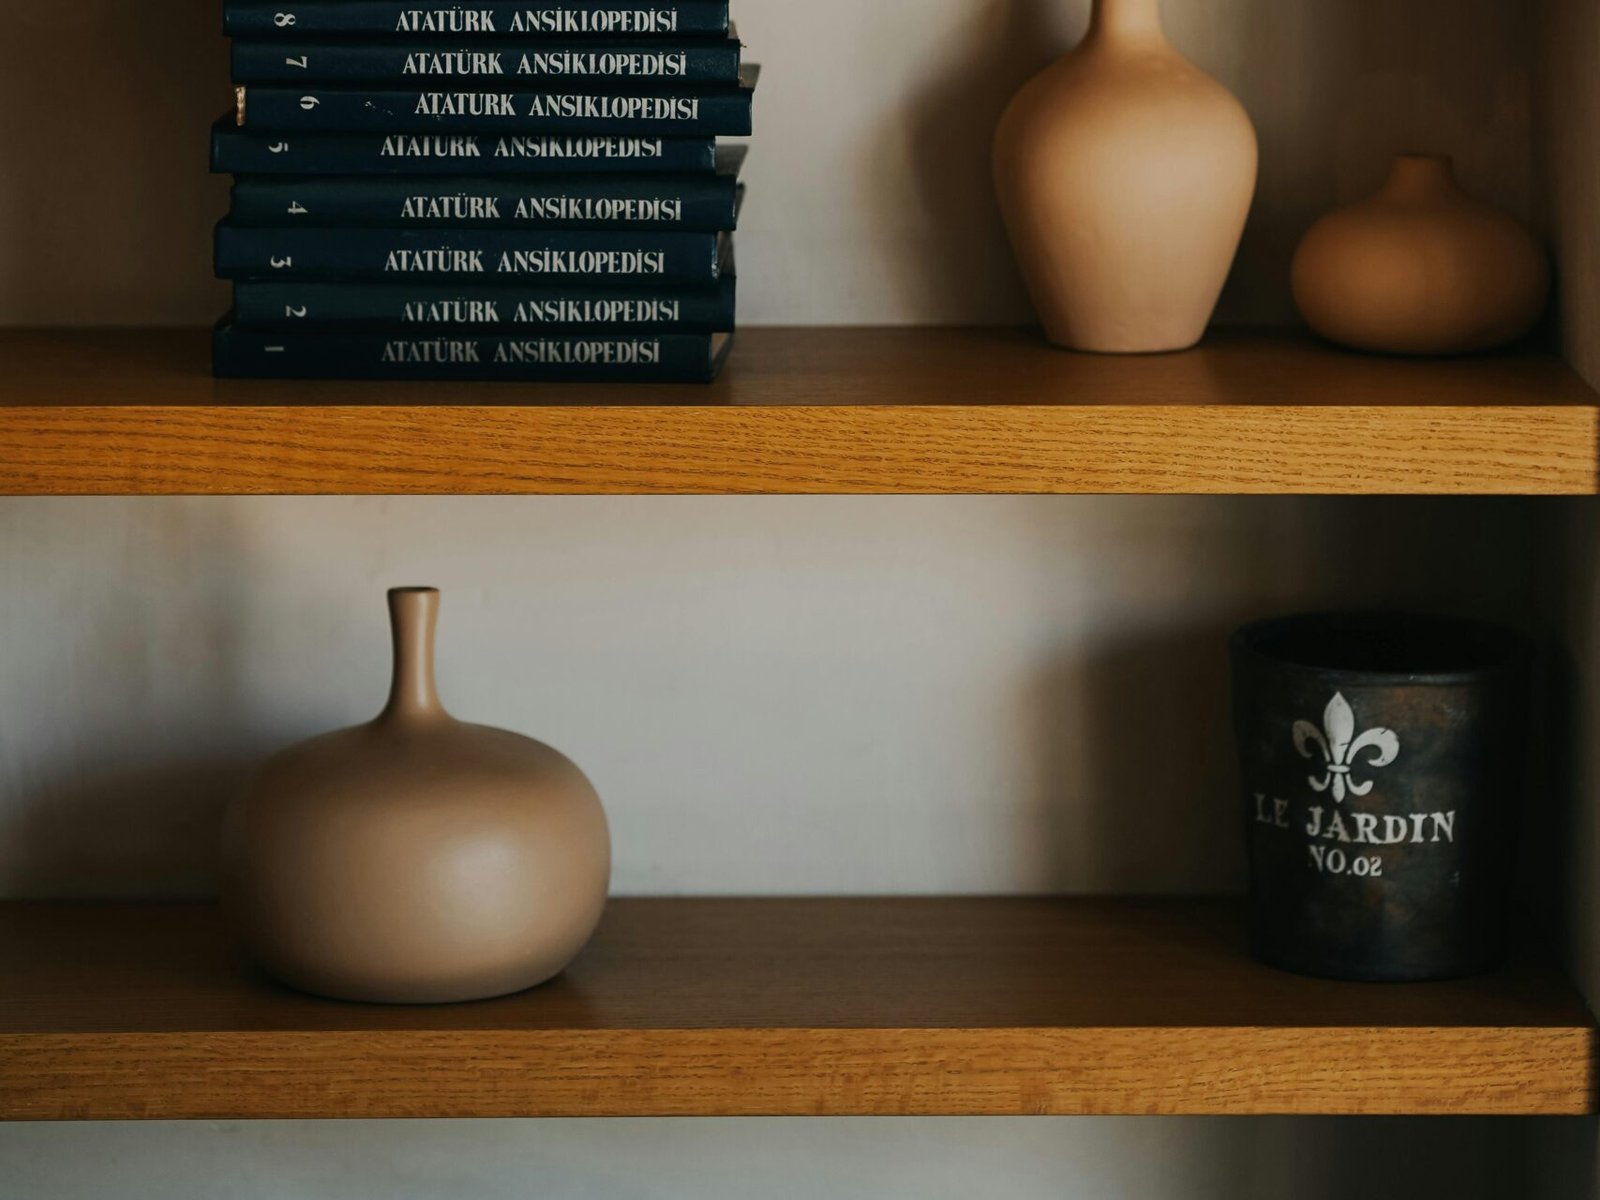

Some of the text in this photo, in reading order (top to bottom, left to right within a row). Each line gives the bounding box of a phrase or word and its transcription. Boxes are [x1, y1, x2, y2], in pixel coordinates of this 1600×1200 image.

[274, 12, 296, 27] 8
[395, 6, 496, 32] ATATÜRK
[285, 55, 308, 69] 7
[402, 49, 504, 75] ATATÜRK
[268, 141, 289, 153] 5
[287, 200, 308, 215] 4
[400, 193, 501, 219] ATATÜRK
[270, 256, 292, 269] 3
[384, 246, 484, 272] ATATÜRK
[286, 305, 307, 318] 2
[401, 299, 500, 322] ATATÜRK
[381, 338, 480, 363] ATATÜRK
[1254, 792, 1456, 845] LE JARDIN
